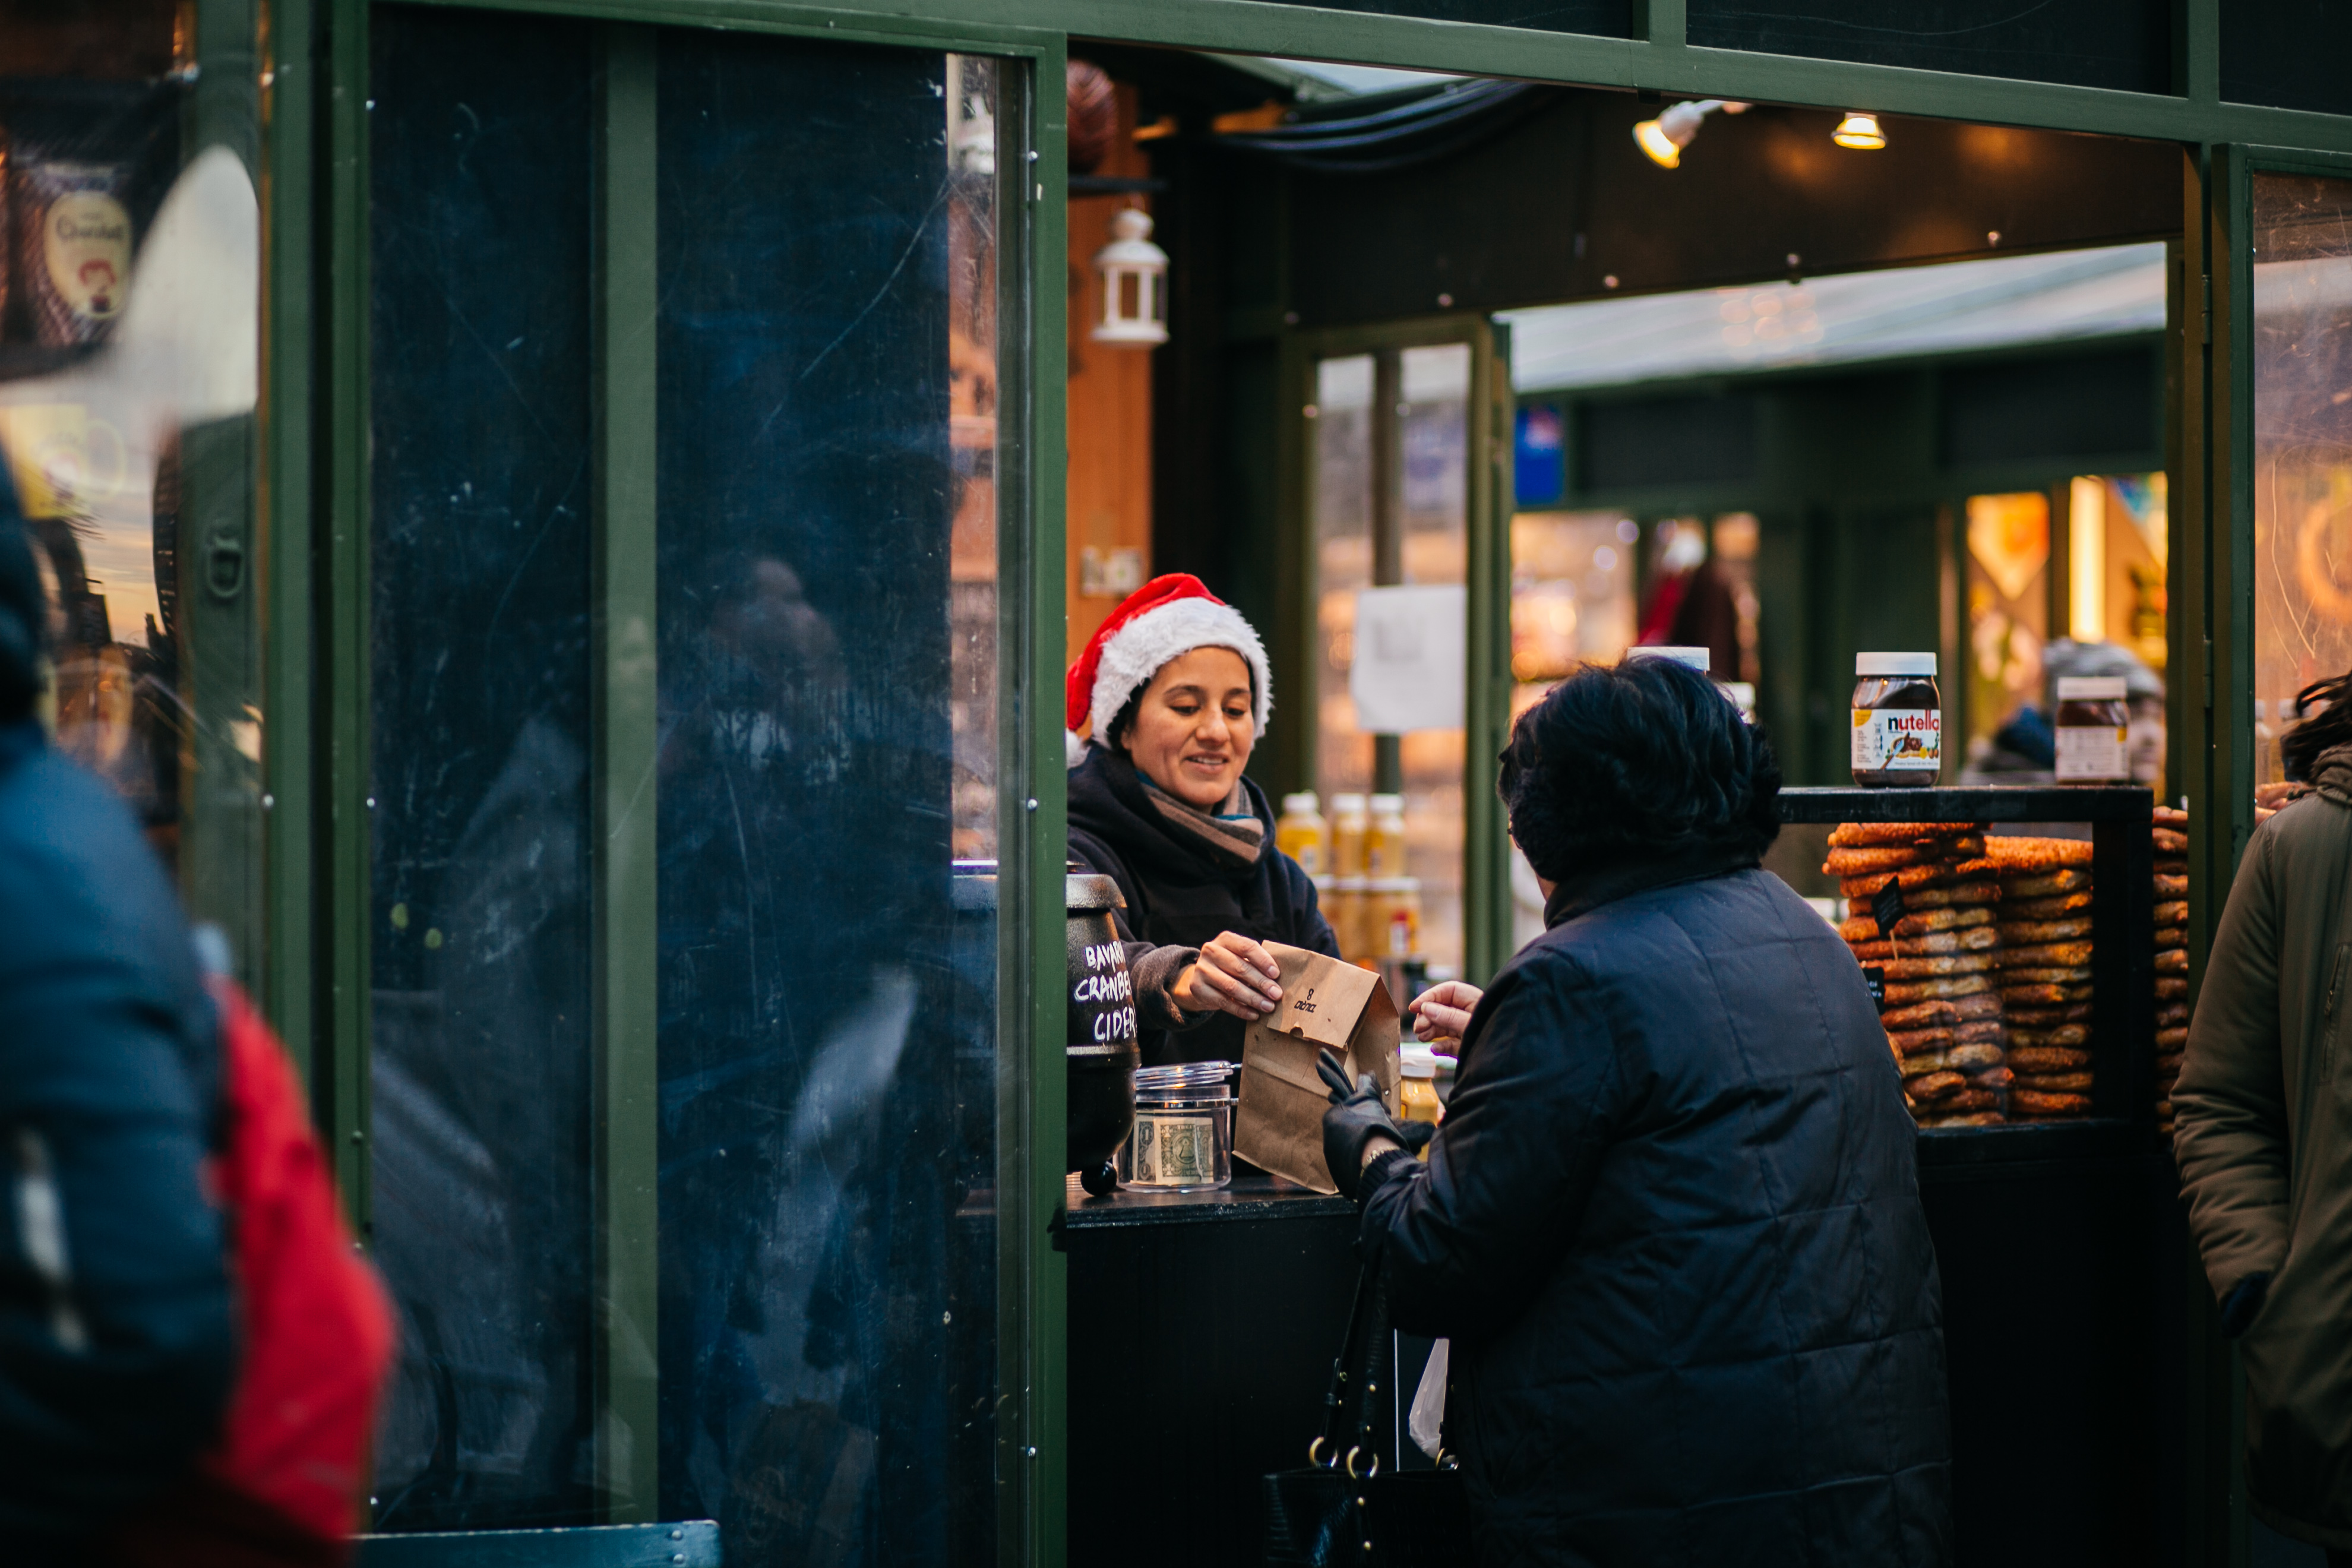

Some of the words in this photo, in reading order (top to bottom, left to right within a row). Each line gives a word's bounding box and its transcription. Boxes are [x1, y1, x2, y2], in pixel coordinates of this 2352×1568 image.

[1888, 709, 1939, 731] nutella
[1085, 941, 1126, 973] BAVARI
[1074, 970, 1132, 1003] CRANBE
[1307, 988, 1314, 1001] 8
